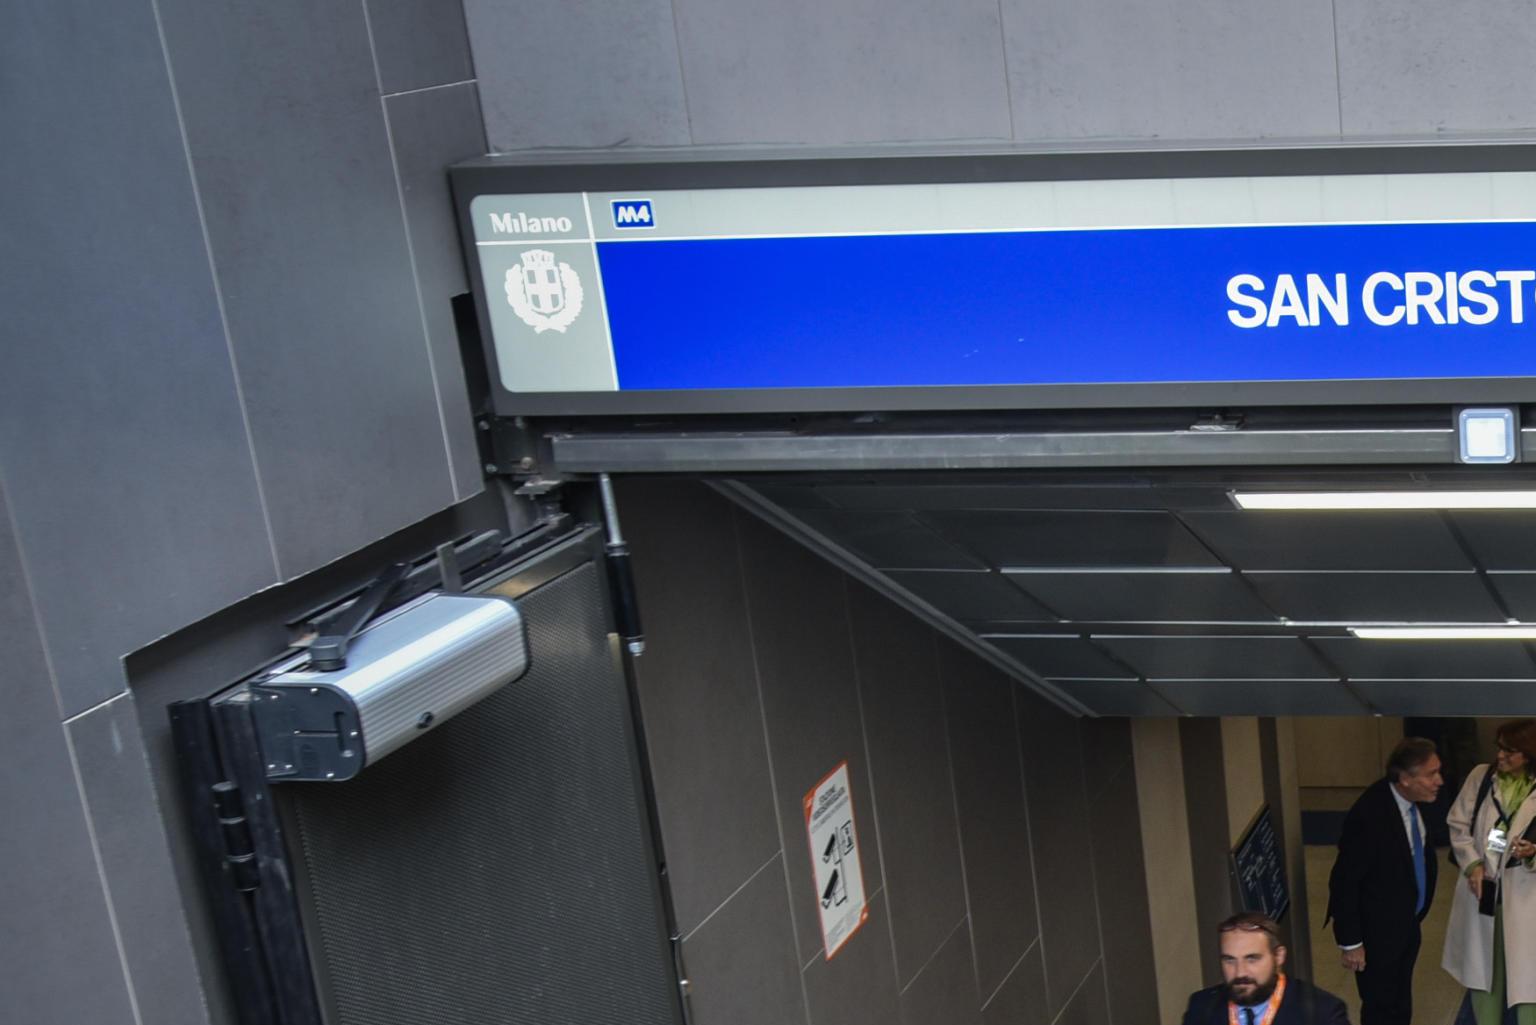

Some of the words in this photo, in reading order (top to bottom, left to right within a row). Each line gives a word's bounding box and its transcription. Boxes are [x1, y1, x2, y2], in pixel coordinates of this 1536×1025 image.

[488, 211, 573, 234] Milano
[617, 204, 651, 224] M4
[1226, 272, 1349, 329] SAN
